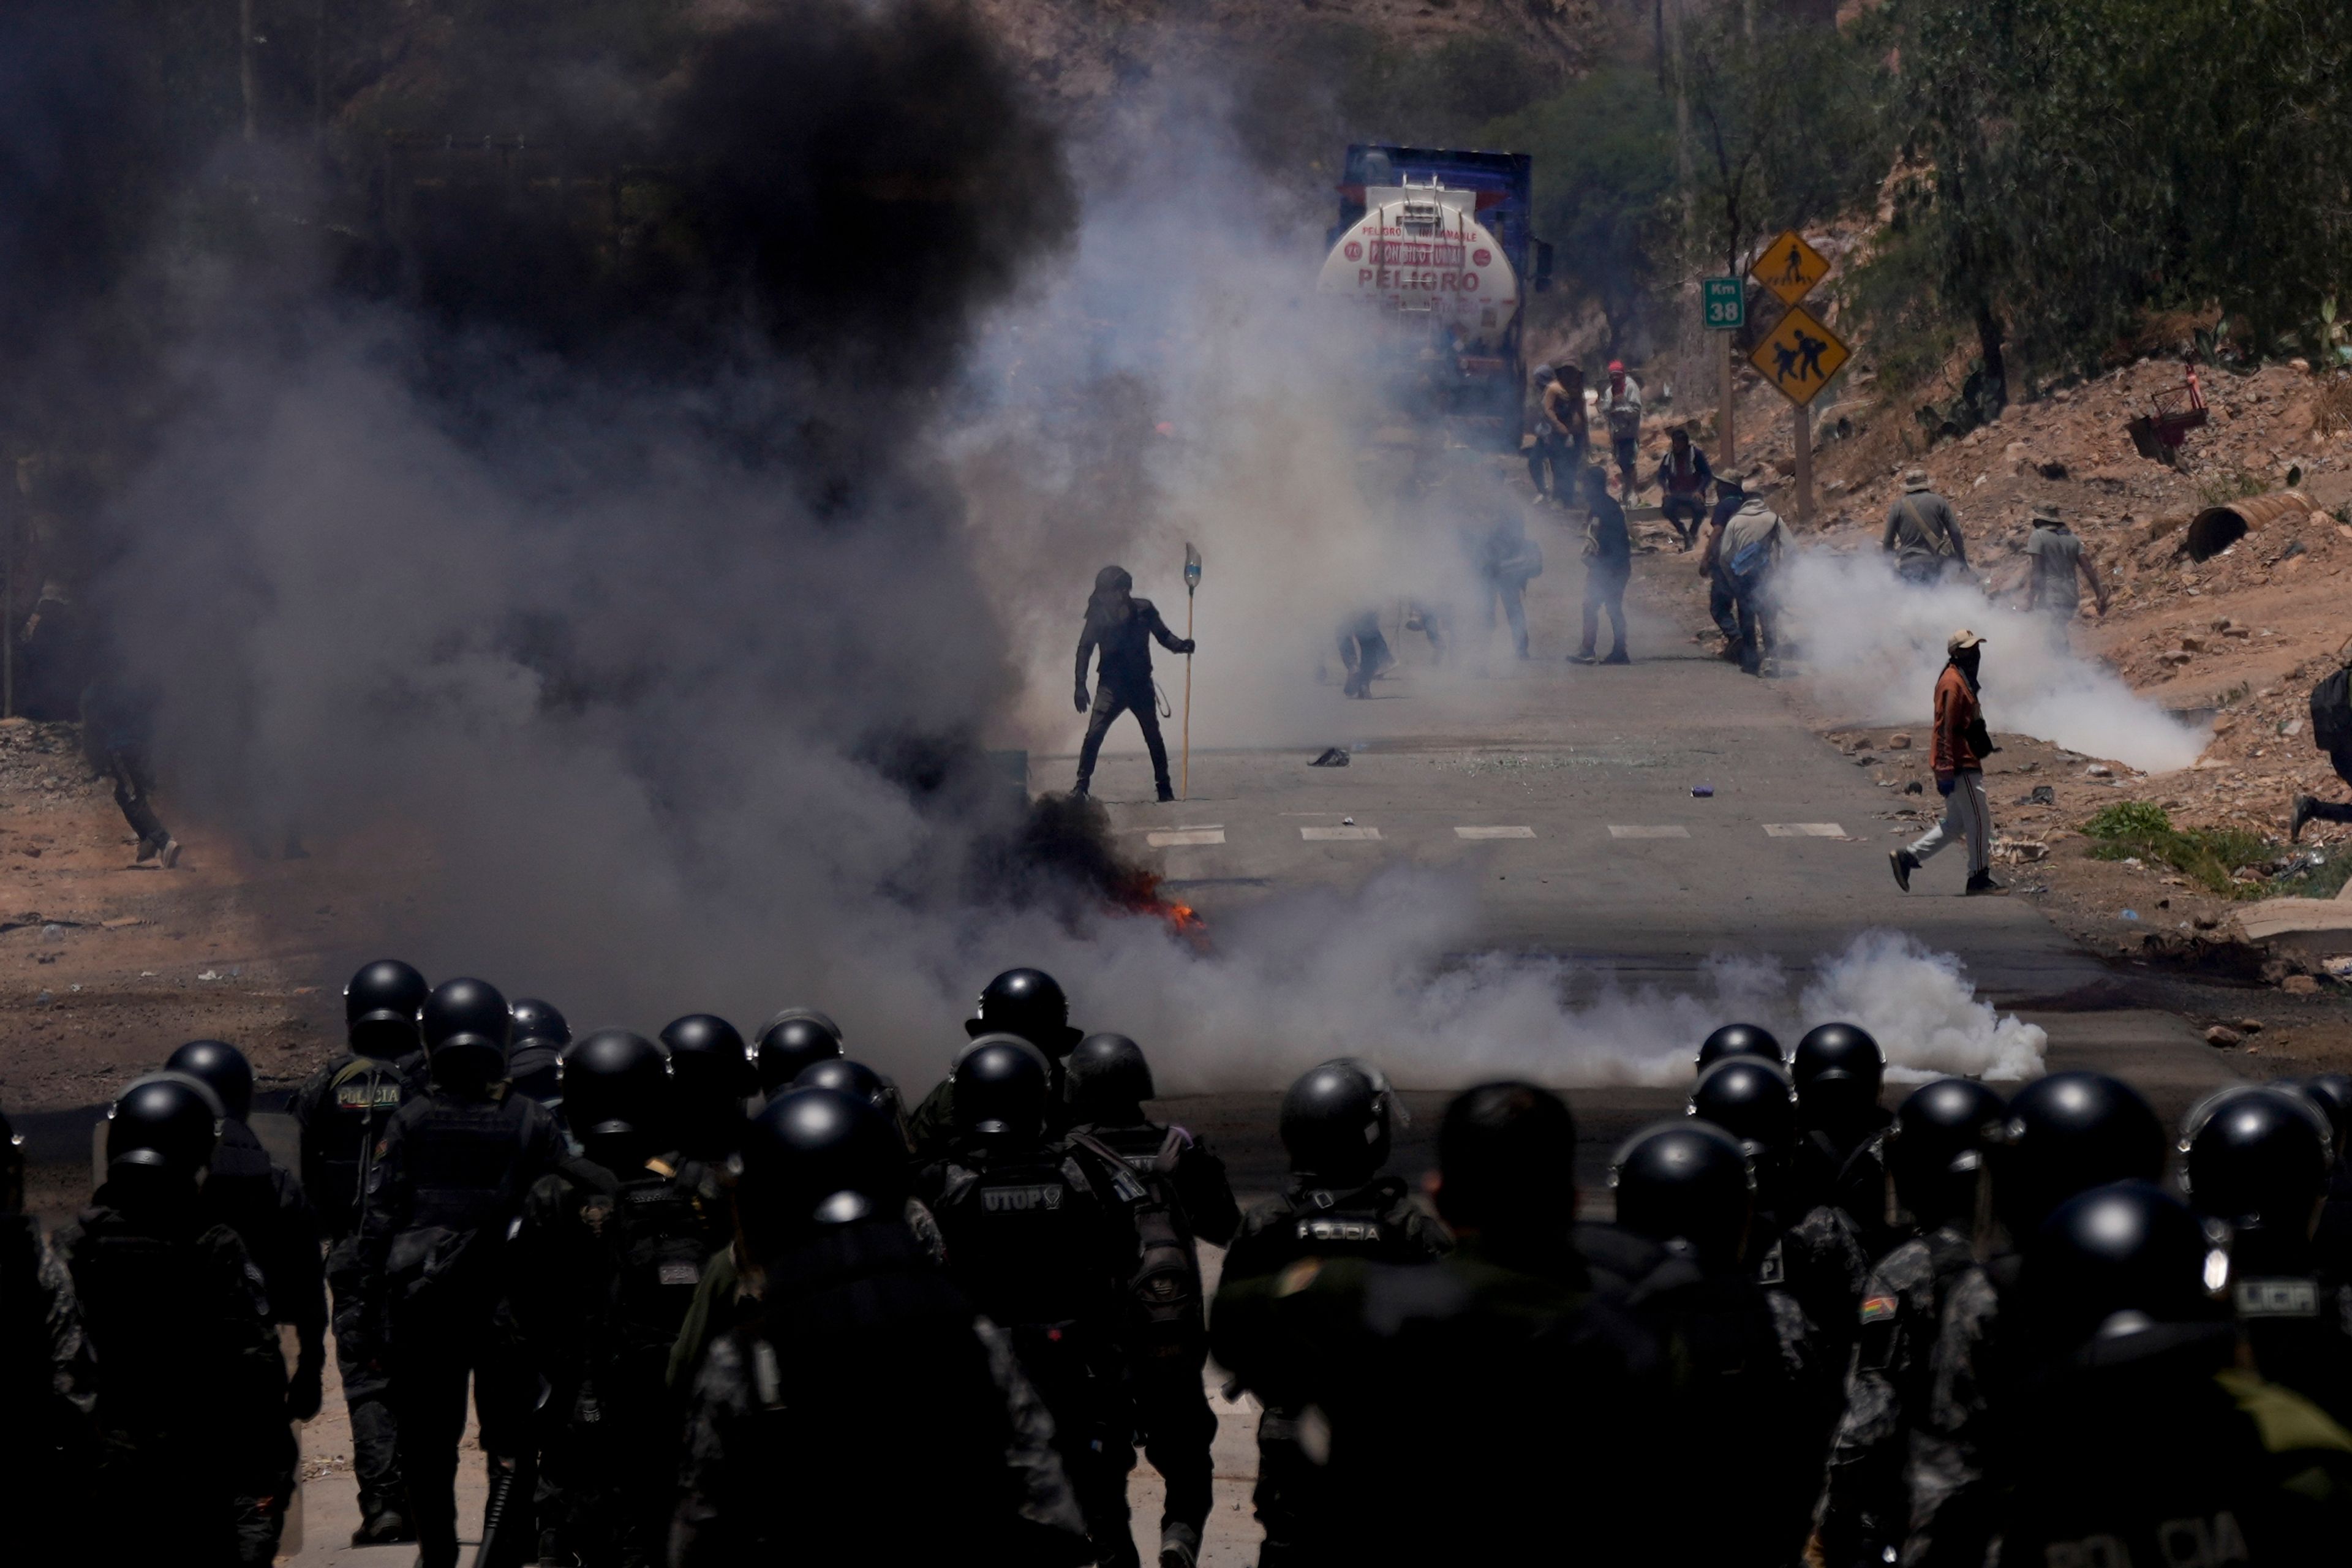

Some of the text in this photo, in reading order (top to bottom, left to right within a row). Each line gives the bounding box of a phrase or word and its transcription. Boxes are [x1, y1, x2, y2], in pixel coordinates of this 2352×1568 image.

[1362, 226, 1401, 236] PELGRO
[1358, 268, 1480, 293] PELIGRO
[1711, 284, 1736, 295] Km
[1709, 302, 1738, 321] 38
[338, 1088, 399, 1104] POLCIA
[984, 1189, 1042, 1212] UTOP
